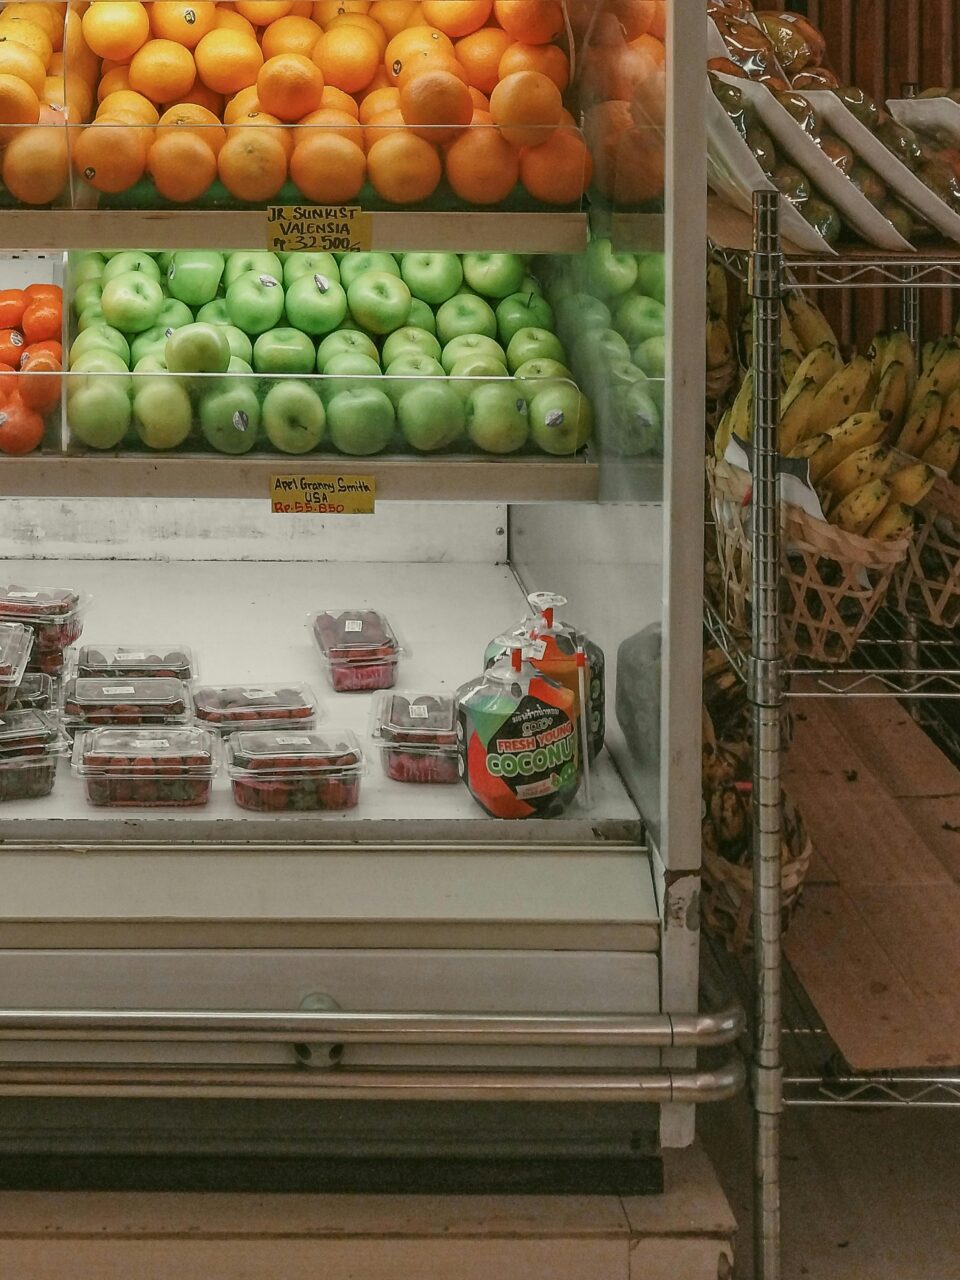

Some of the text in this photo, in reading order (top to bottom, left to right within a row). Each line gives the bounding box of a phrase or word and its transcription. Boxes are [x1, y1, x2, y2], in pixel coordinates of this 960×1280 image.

[293, 206, 358, 221] SUNKIST
[279, 222, 351, 236] VALENSIA
[274, 477, 371, 493] Apel Granny Smith
[304, 491, 328, 503] USA
[496, 736, 536, 753] FRESH
[536, 721, 572, 747] YOUNG
[486, 735, 577, 777] COCONU
